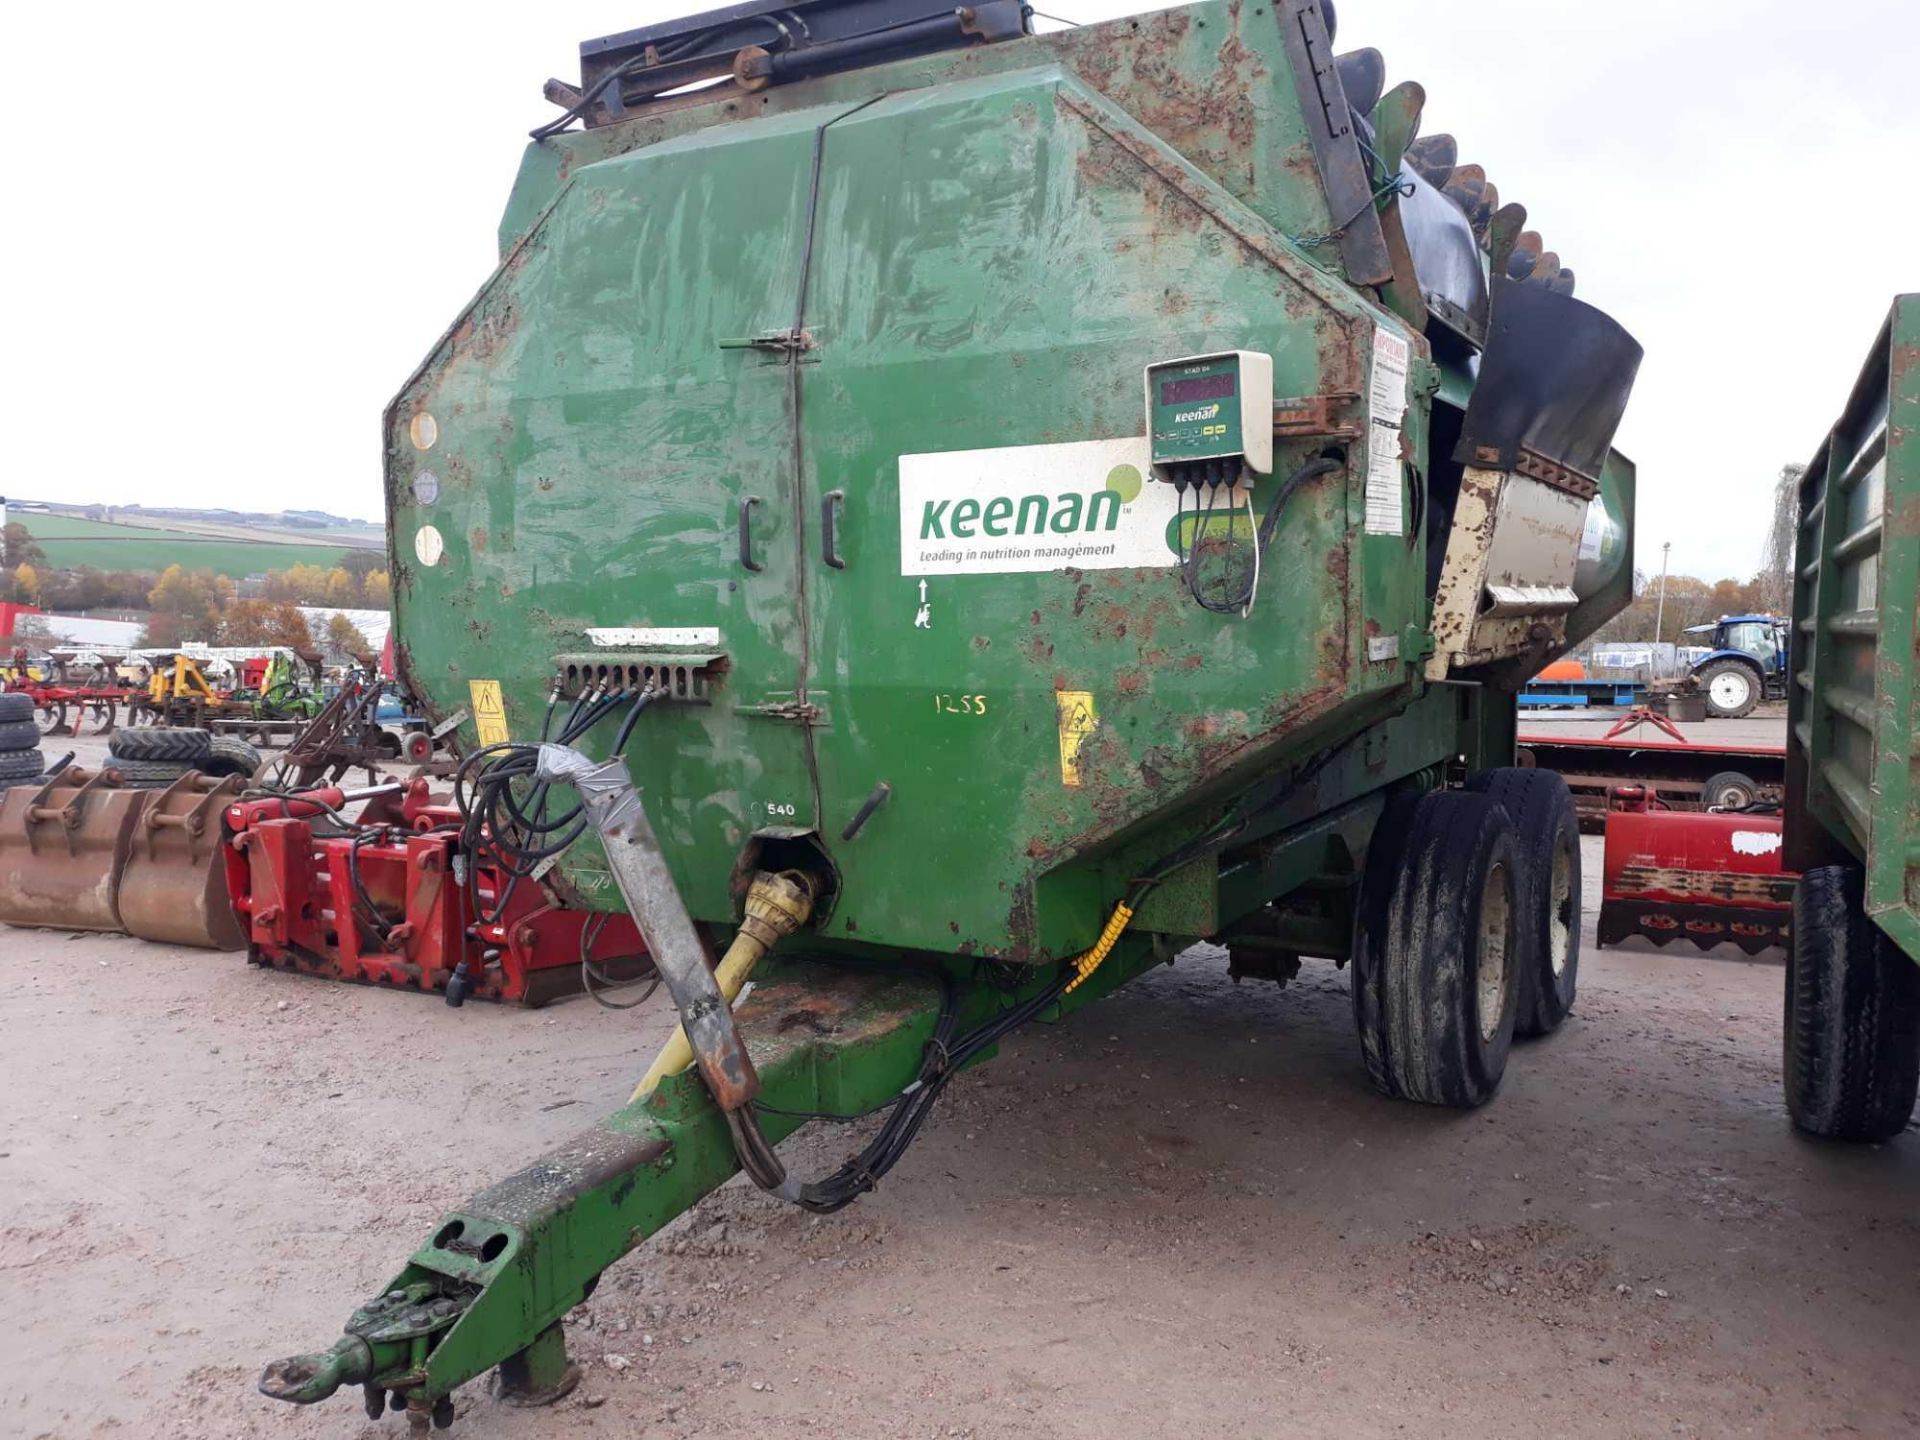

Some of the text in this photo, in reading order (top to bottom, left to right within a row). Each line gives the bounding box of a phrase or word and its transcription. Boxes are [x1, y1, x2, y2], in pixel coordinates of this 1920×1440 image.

[920, 543, 1116, 564] Leading in nutrition management
[767, 803, 796, 816] 540
